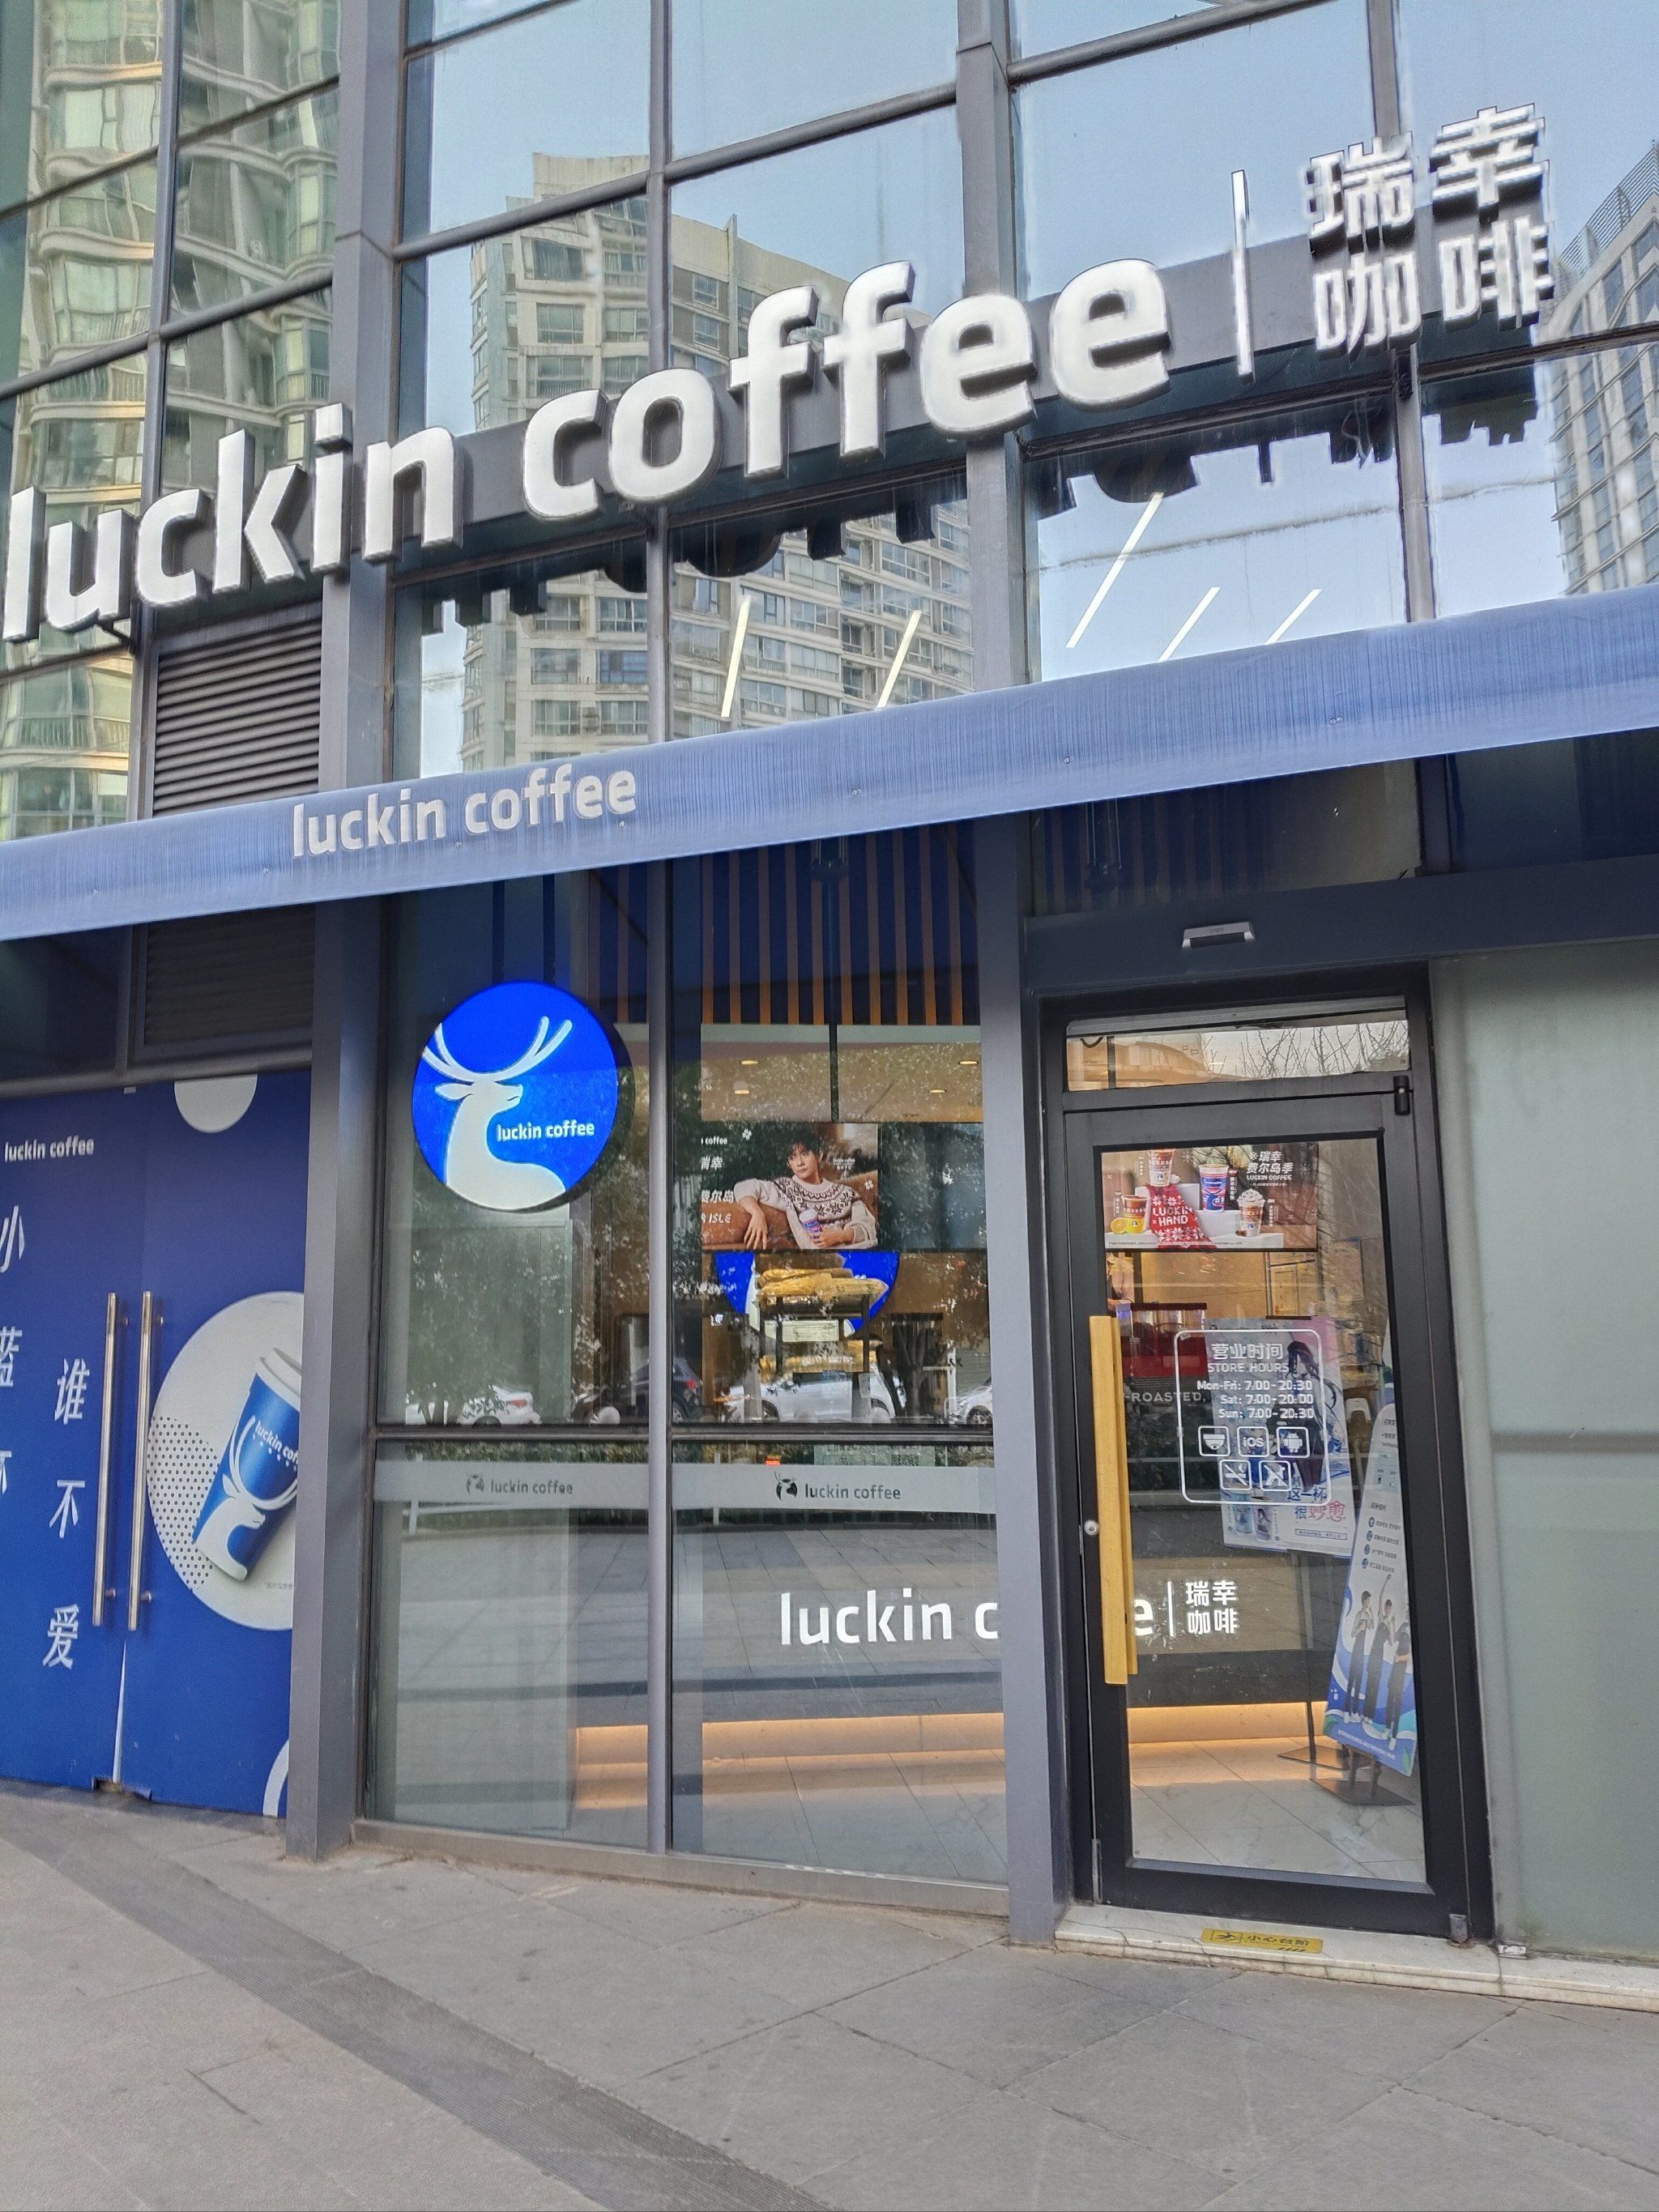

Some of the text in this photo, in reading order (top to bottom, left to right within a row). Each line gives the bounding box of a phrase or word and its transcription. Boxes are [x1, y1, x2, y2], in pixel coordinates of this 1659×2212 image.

[1307, 103, 1548, 237] 瑞幸
[1311, 216, 1552, 355] 咖啡
[2, 259, 1170, 642] luckin coffee
[293, 764, 637, 857] luckin coffee
[497, 1119, 595, 1141] luckin coffee
[4, 1135, 95, 1162] luckin coffee
[705, 1136, 728, 1145] coffee
[1259, 1151, 1282, 1162] 瑞幸
[1246, 1162, 1294, 1174] 费尔岛季
[1152, 1205, 1193, 1217] LUCKIN
[1158, 1215, 1189, 1227] HAND
[1211, 1342, 1284, 1360] 营业时间
[1207, 1362, 1290, 1373] STORE HOURS
[1196, 1379, 1242, 1392] Mon-Fri:
[1220, 1394, 1243, 1405] Sat:
[1218, 1408, 1243, 1419] Sun:
[254, 1419, 284, 1453] luckin
[1243, 1437, 1265, 1449] iOS
[489, 1477, 574, 1495] luckin coffee
[804, 1482, 902, 1500] luckin coffee
[1185, 1579, 1239, 1607] 瑞幸
[781, 1588, 954, 1647] luckin
[1187, 1608, 1241, 1636] 咖啡
